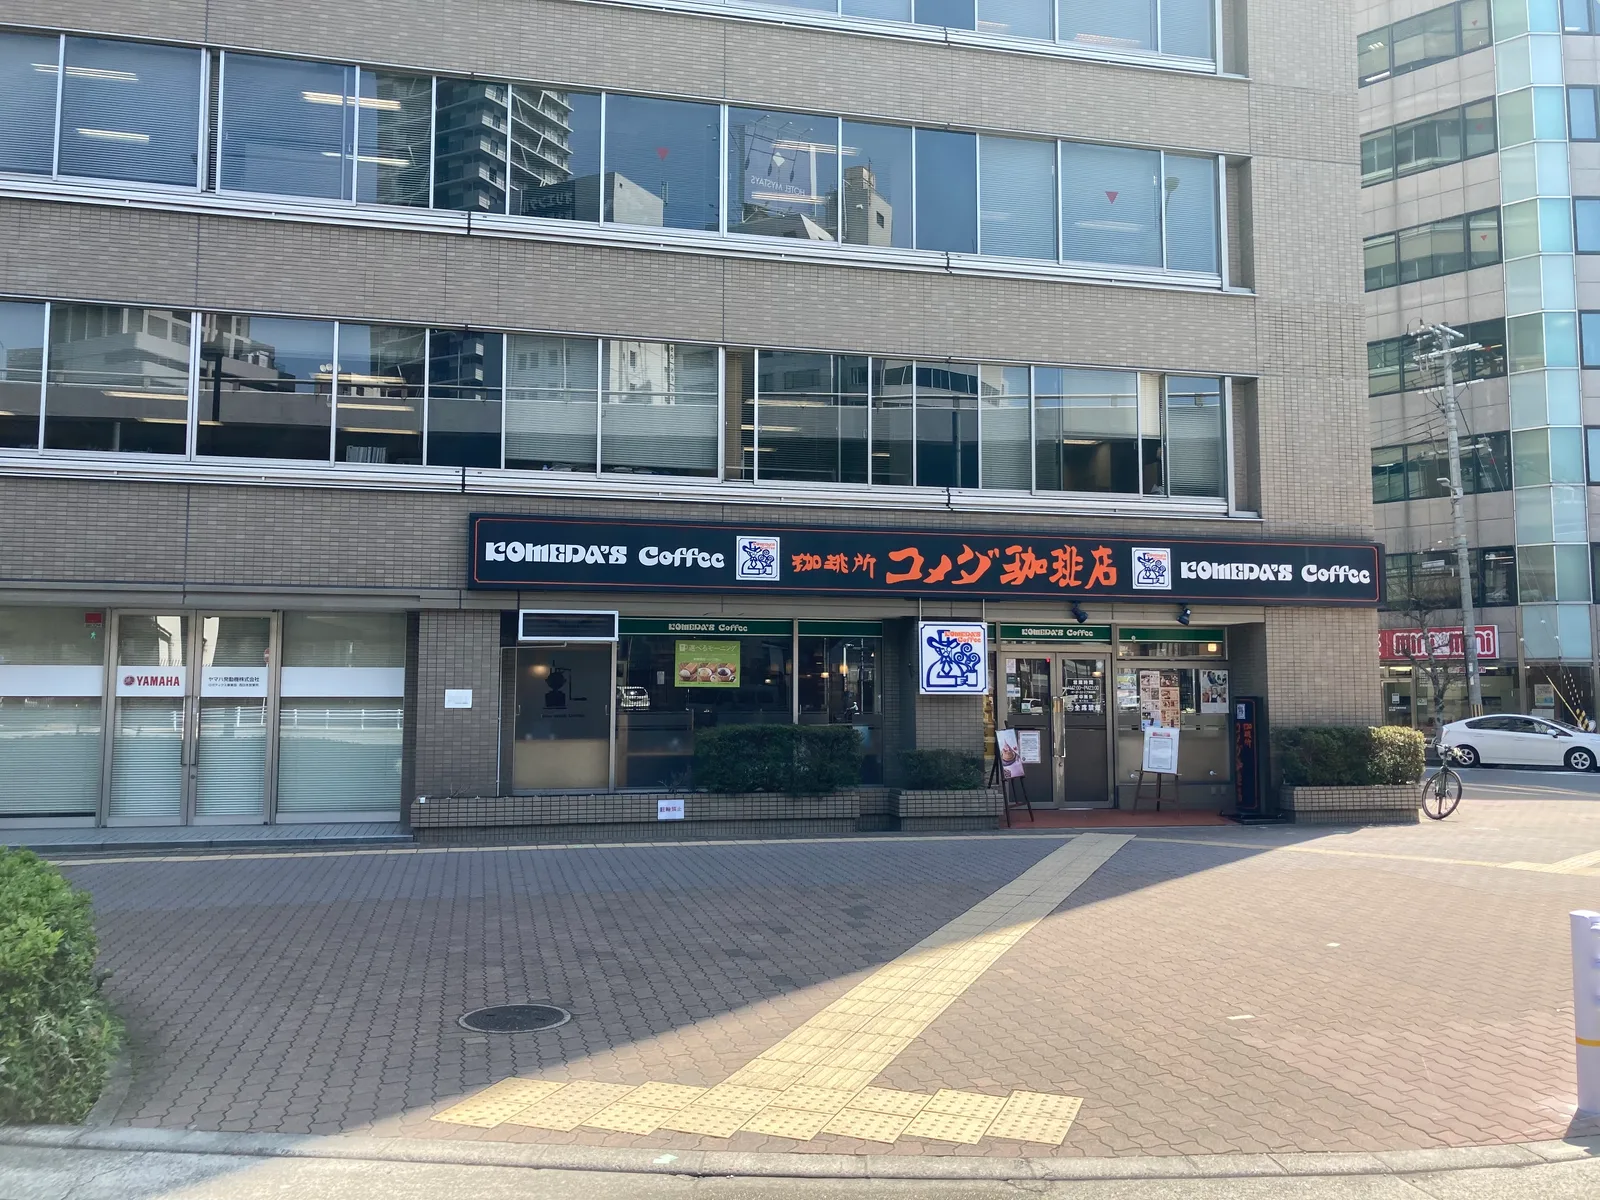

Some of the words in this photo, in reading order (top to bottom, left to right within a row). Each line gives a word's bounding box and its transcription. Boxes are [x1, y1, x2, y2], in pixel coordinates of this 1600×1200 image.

[486, 541, 628, 564] KOMEDA'S
[638, 545, 726, 569] Coffee
[791, 552, 877, 579] 珈琲所
[886, 545, 1117, 589] コメダ珈琲店
[1181, 559, 1293, 582] KOMEDA'S
[1301, 564, 1371, 585] Coffee
[668, 622, 715, 631] KOMEDA'S
[718, 623, 748, 632] Coffee
[1021, 628, 1064, 636] KOMEDA'S
[1066, 629, 1094, 637] Coffee
[136, 676, 180, 687] YAMAHA
